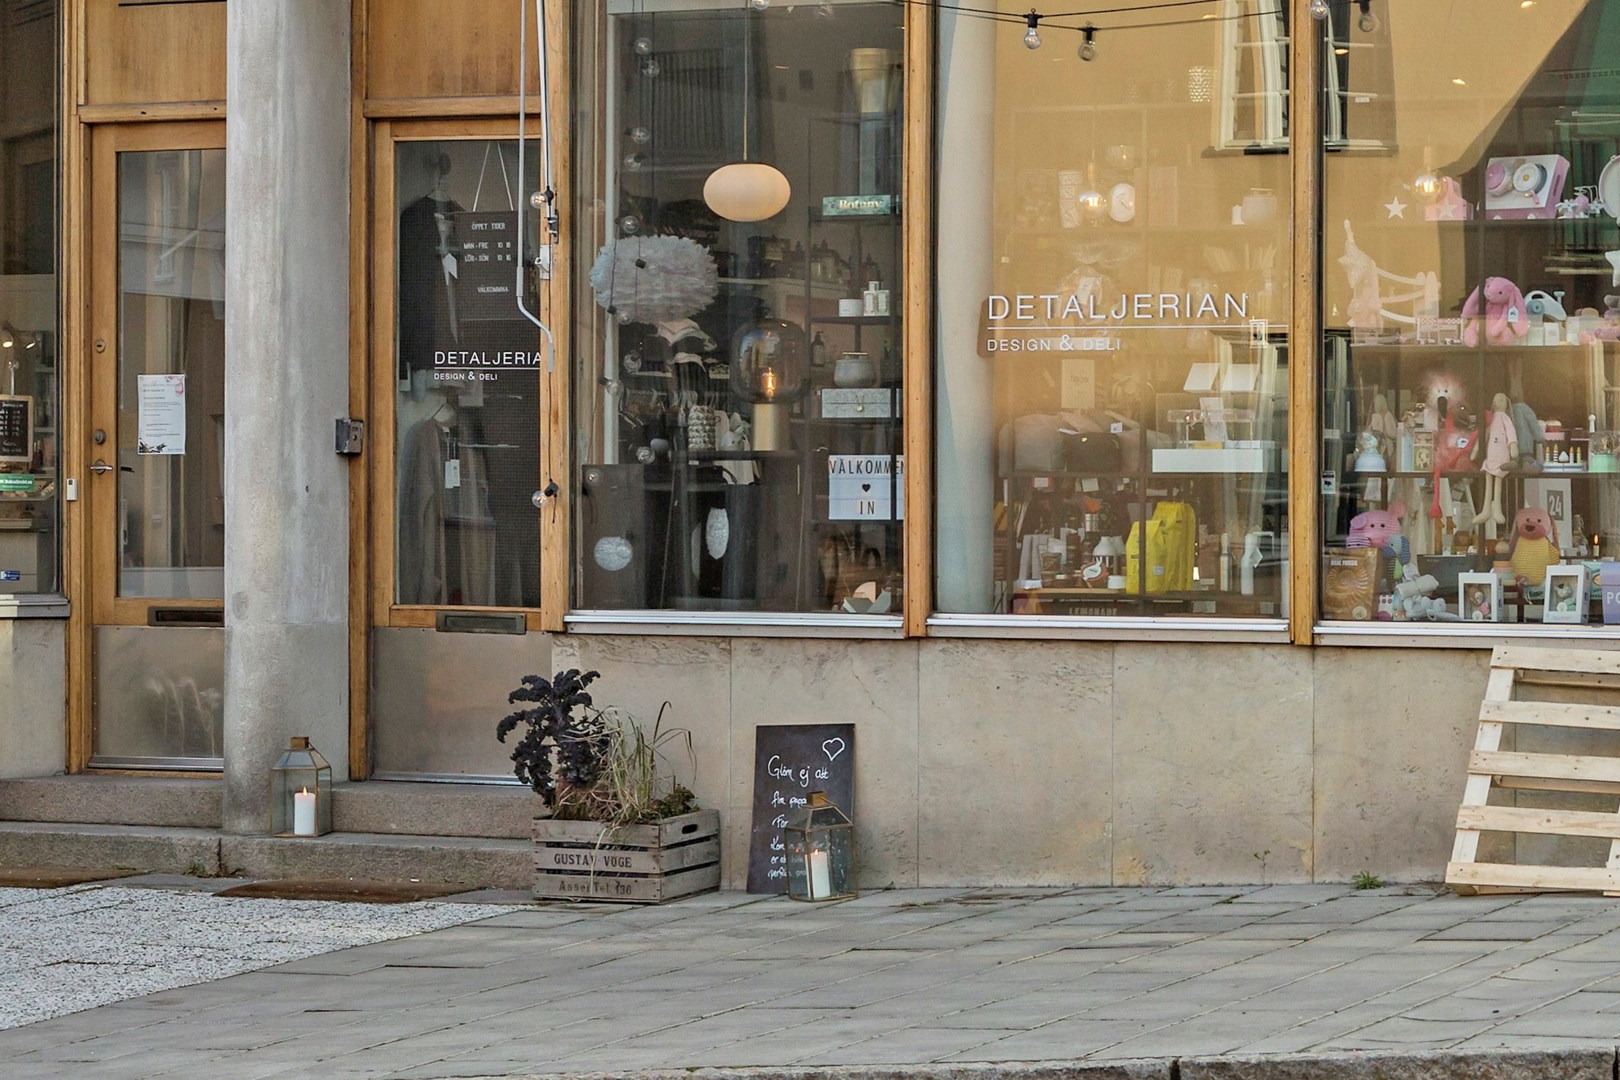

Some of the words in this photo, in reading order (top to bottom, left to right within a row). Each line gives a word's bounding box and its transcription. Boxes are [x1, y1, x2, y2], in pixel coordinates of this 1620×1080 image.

[988, 292, 1248, 320] DETALJERIAN
[987, 339, 1051, 352] DESIGN
[1060, 334, 1074, 352] &
[1083, 338, 1120, 351] DELI
[468, 370, 476, 380] &
[860, 501, 874, 514] IN
[1549, 495, 1562, 516] 24
[799, 766, 811, 788] ej
